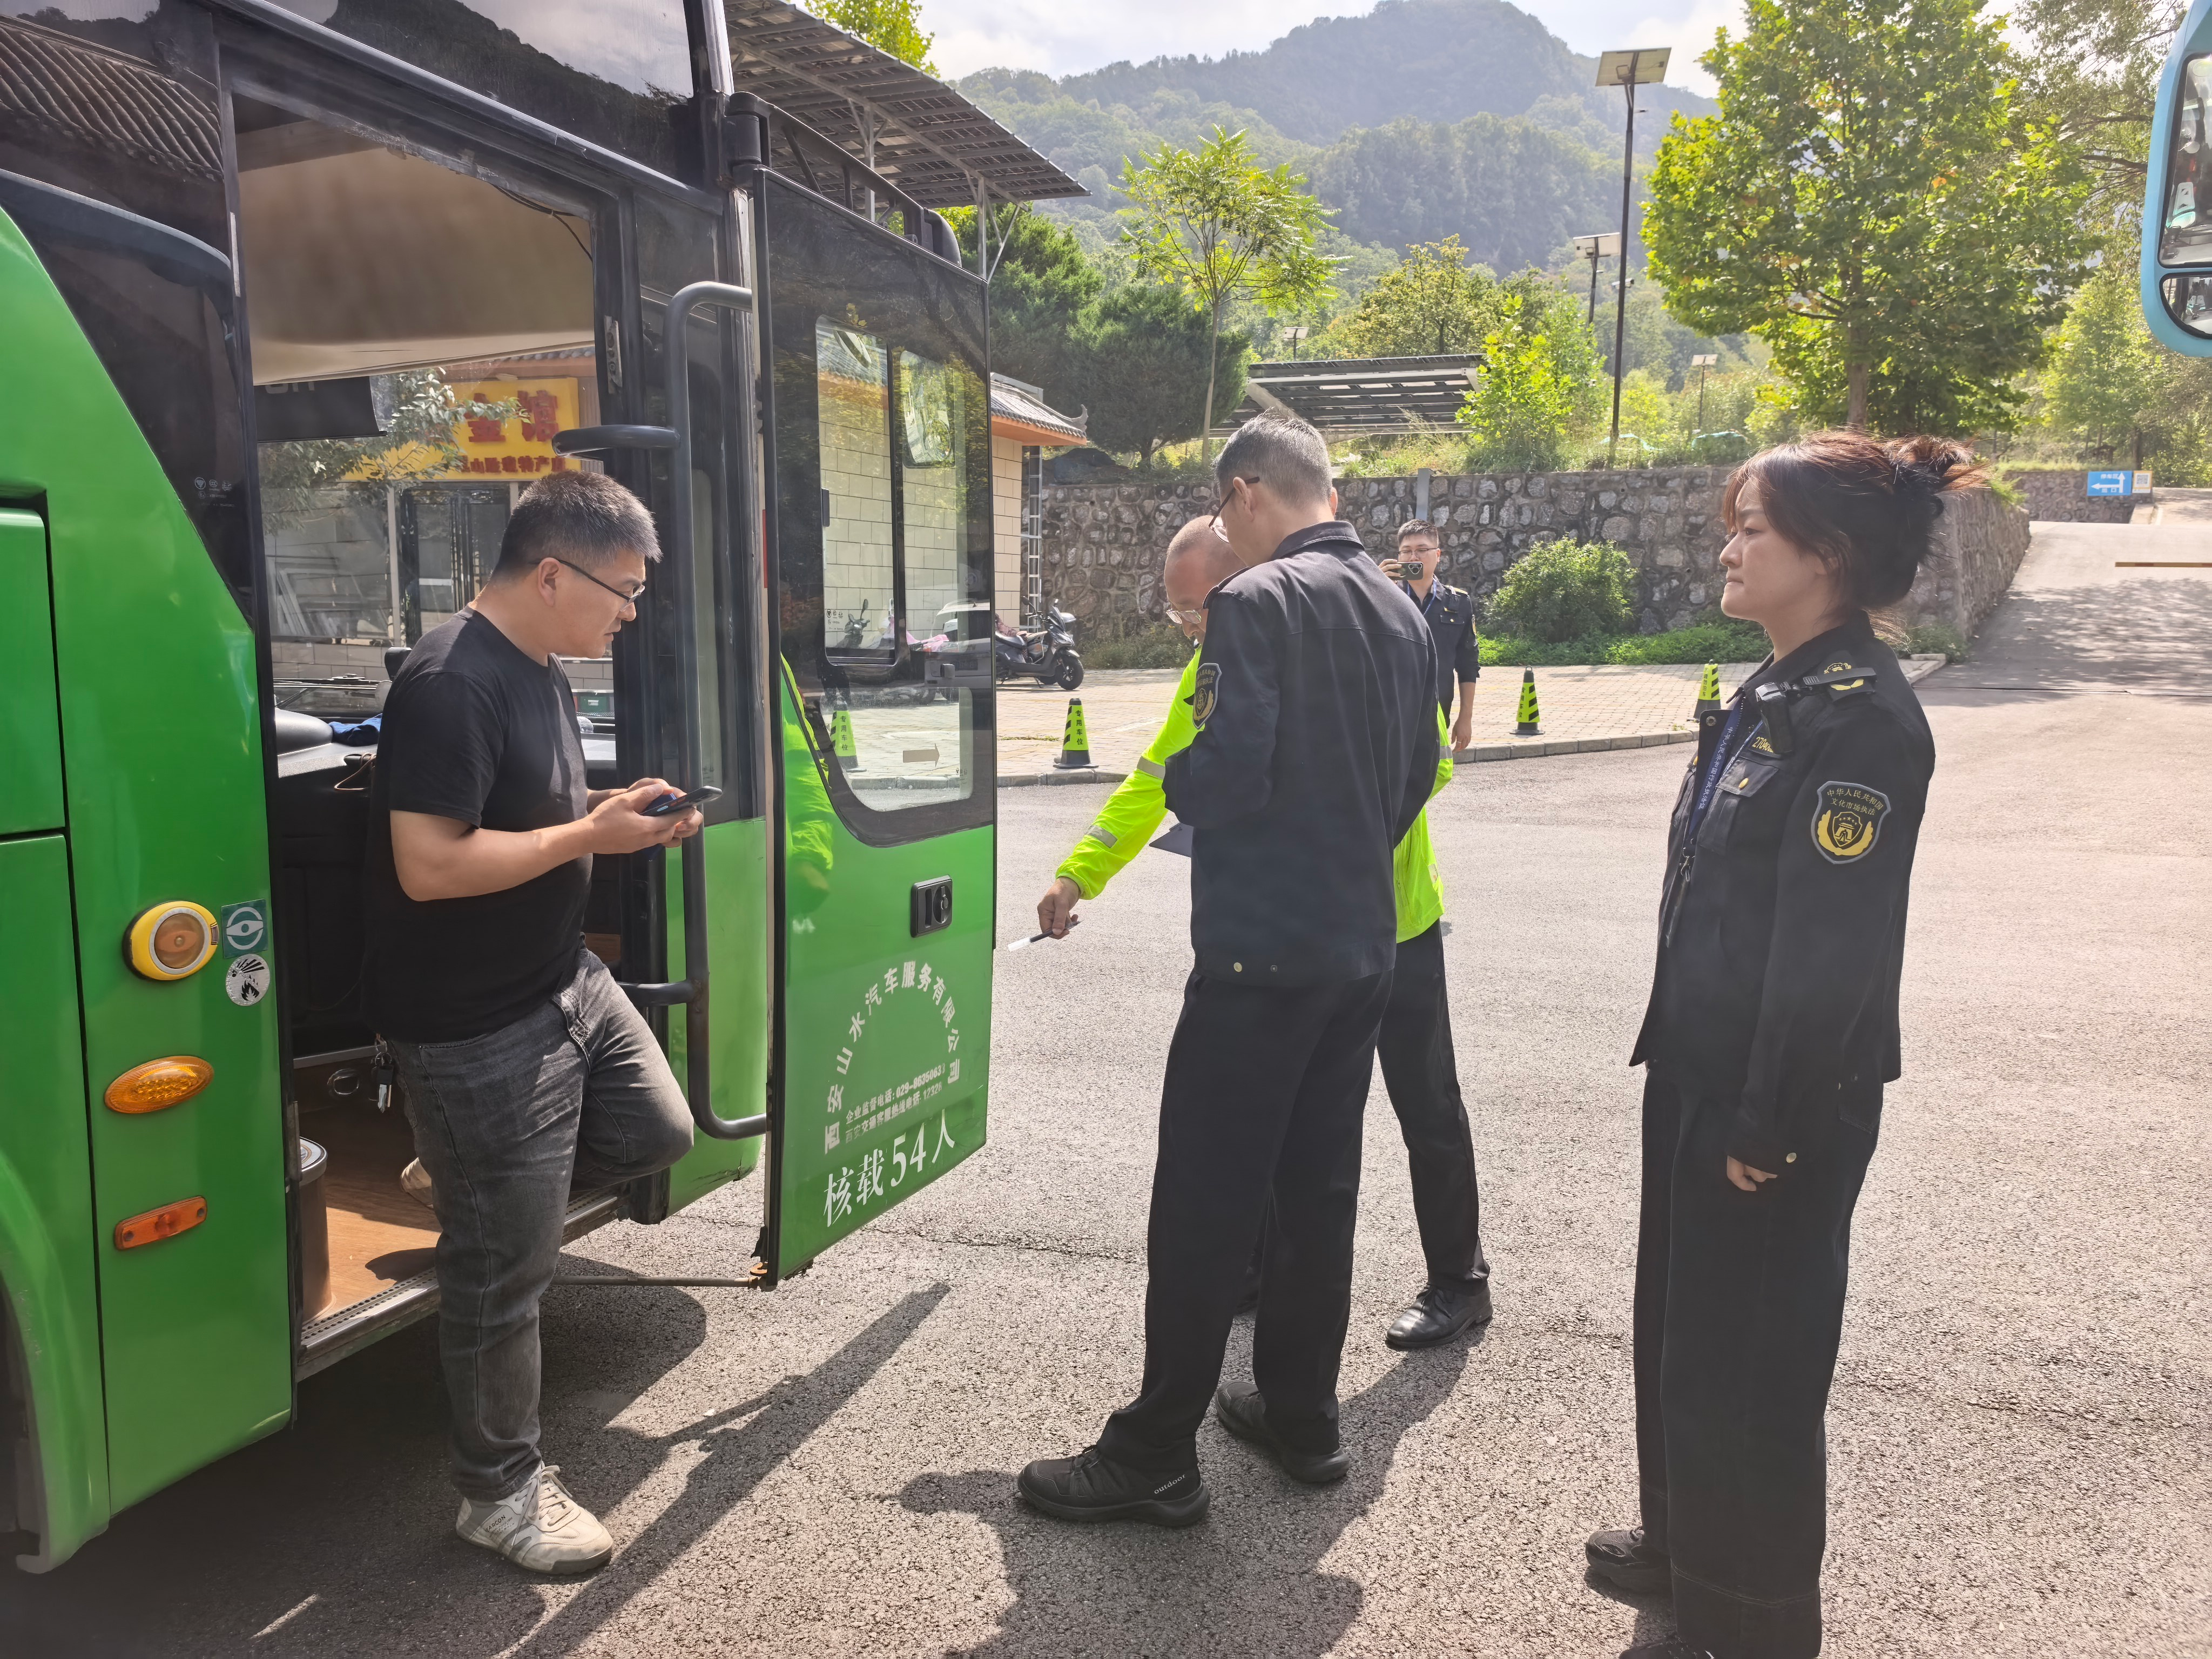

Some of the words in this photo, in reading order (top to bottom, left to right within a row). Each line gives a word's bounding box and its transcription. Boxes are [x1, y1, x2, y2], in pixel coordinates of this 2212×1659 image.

[840, 716, 848, 751] 专用车位
[1075, 710, 1083, 745] 专用车位
[1827, 788, 1884, 811] 中华人民共和国
[1830, 798, 1876, 816] 文化市场执法
[825, 960, 960, 1155] 西安山水汽车服务有限公司
[824, 1109, 955, 1227] 核载54人
[1154, 1474, 1185, 1494] outdoor
